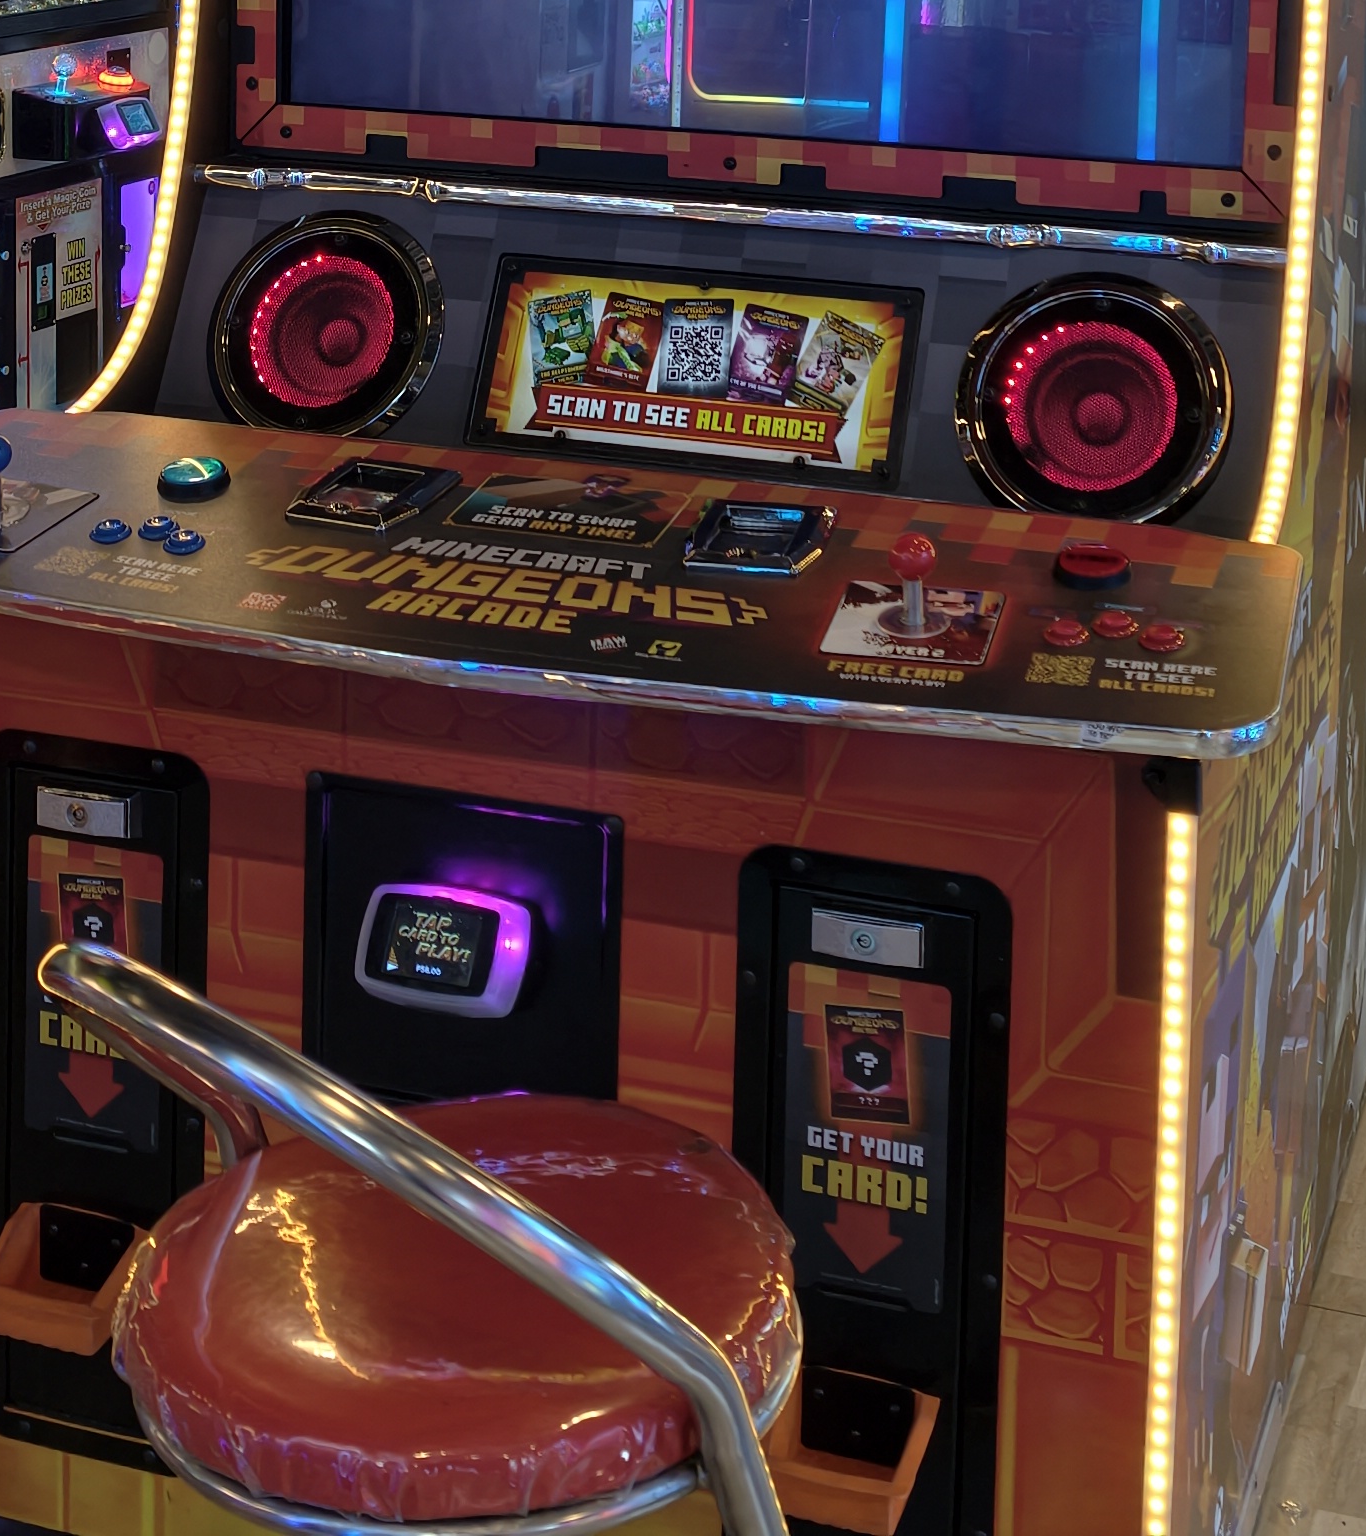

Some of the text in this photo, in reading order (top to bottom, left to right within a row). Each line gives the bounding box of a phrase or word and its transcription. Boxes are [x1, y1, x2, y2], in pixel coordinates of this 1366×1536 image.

[20, 185, 97, 213] Insert Magic Coin
[35, 198, 92, 221] Get Your Prize
[66, 238, 86, 261] WIN
[61, 259, 92, 286] THESE
[60, 284, 93, 311] PRIZES
[546, 394, 826, 444] SCAN TO SEE ALL CARDS!
[471, 513, 636, 540] GEAR ANY TIME!
[487, 504, 637, 528] SCAN TO SWAP
[112, 555, 155, 569] SCAN
[390, 536, 652, 580] MINECRAFT
[88, 571, 117, 584] ALL
[118, 565, 176, 582] TO SEE
[261, 544, 741, 627] DUNGEONS
[364, 589, 578, 634] ARCADE
[827, 659, 965, 683] FREE CARD
[1104, 657, 1218, 677] SCAN HERE
[1124, 670, 1196, 686] TO SEE
[1098, 678, 1216, 698] ALL CARDS!
[63, 882, 120, 897] DUNGEONS
[415, 911, 453, 931] TAP
[398, 925, 460, 946] CARD TO
[415, 941, 472, 963] PLAY!
[831, 1015, 900, 1031] DUNGEONS
[806, 1125, 925, 1168] GET YOUR
[800, 1154, 929, 1215] CARD!
